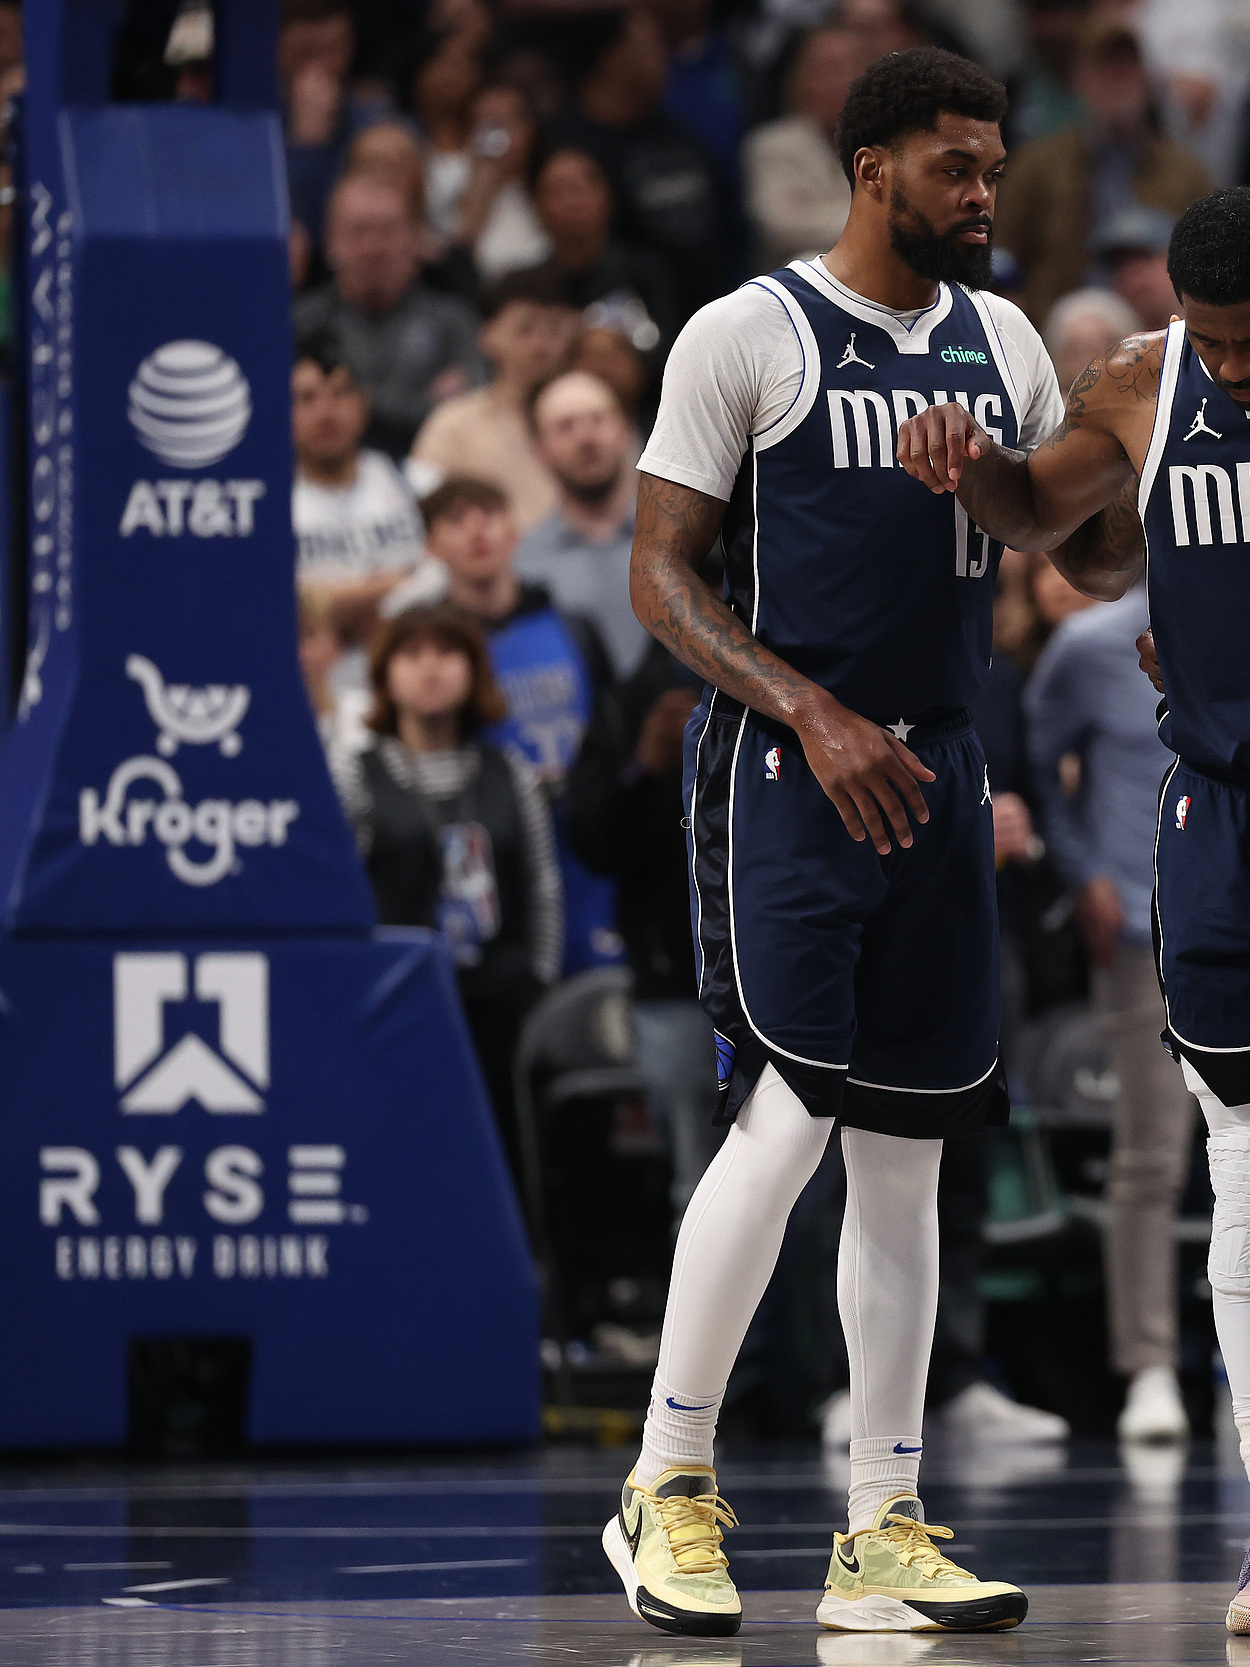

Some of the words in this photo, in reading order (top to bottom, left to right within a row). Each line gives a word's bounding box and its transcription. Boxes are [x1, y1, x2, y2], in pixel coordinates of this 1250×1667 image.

[940, 345, 989, 365] chime
[826, 389, 1003, 469] MS
[119, 480, 266, 537] AT&T
[80, 755, 300, 888] Kroger
[39, 1144, 345, 1226] RYSE
[55, 1235, 197, 1281] ENERGY
[212, 1233, 328, 1280] DRINK
